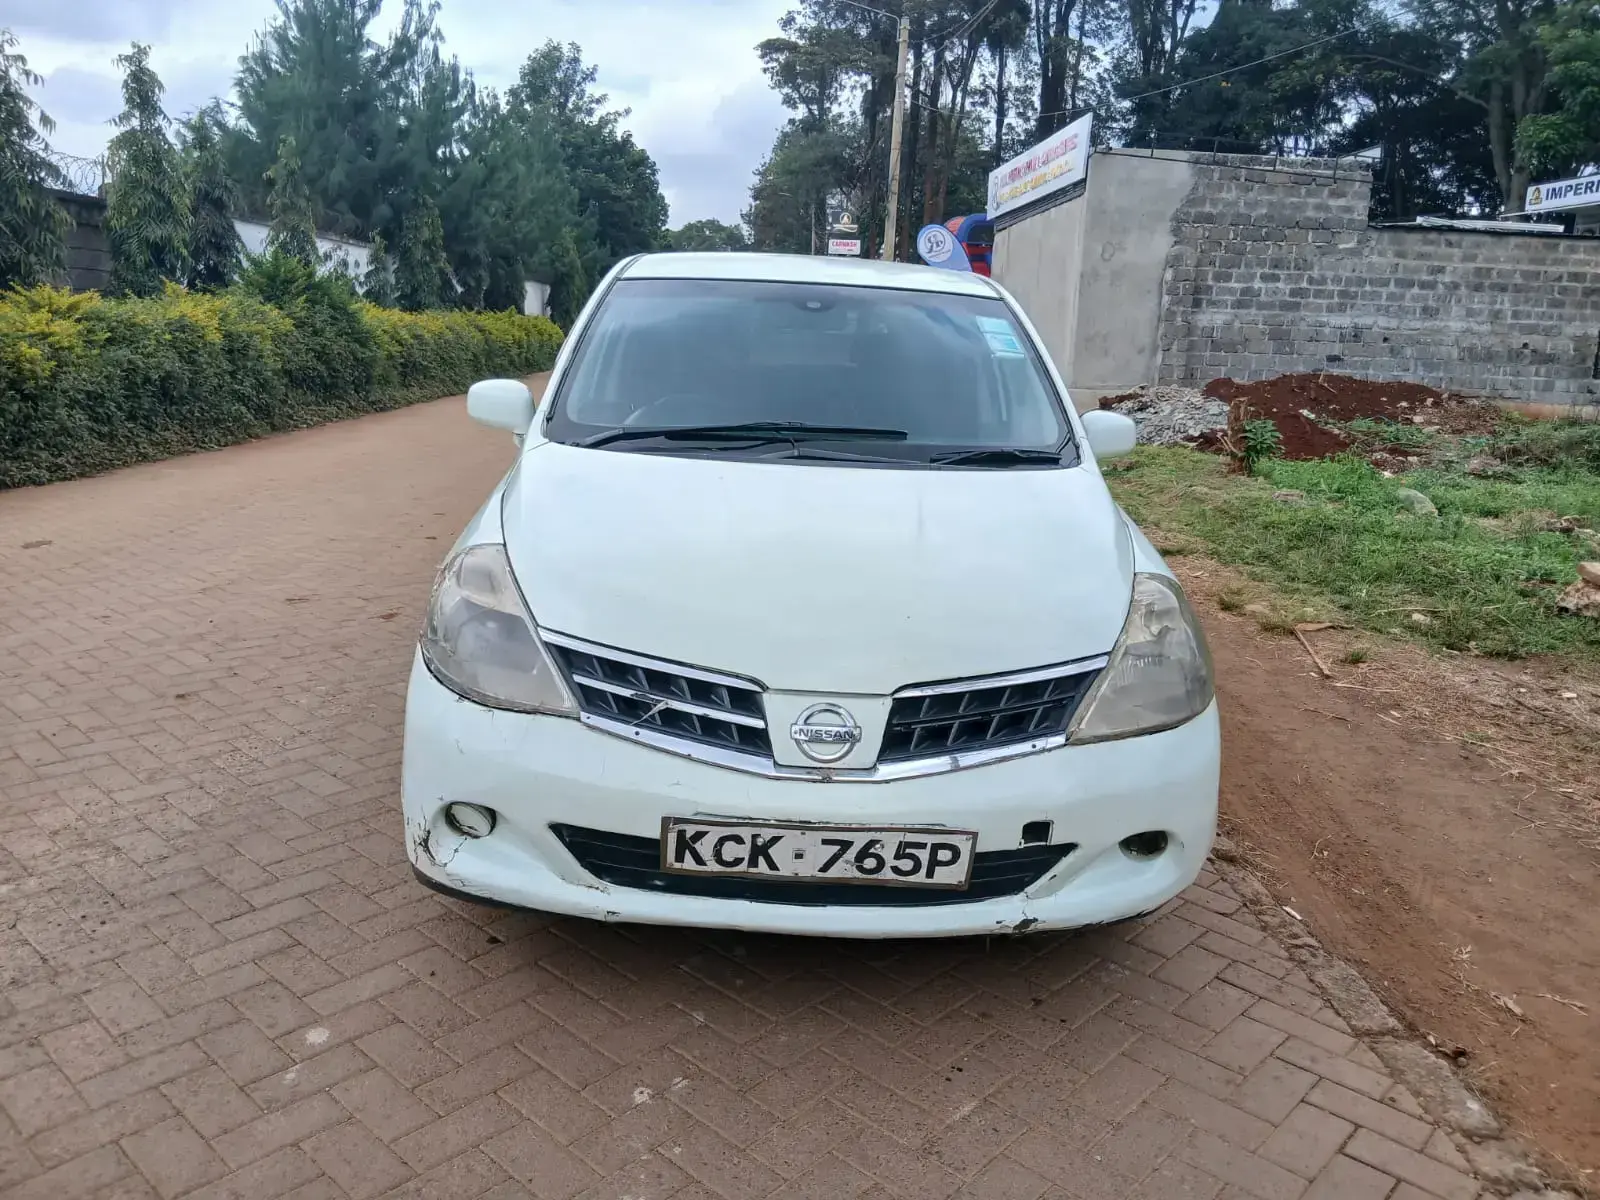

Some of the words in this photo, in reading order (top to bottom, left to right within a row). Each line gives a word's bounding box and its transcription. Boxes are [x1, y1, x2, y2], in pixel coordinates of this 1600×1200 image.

[798, 727, 854, 741] NISSAN
[674, 828, 785, 872] KCK
[817, 838, 962, 879] 765P
